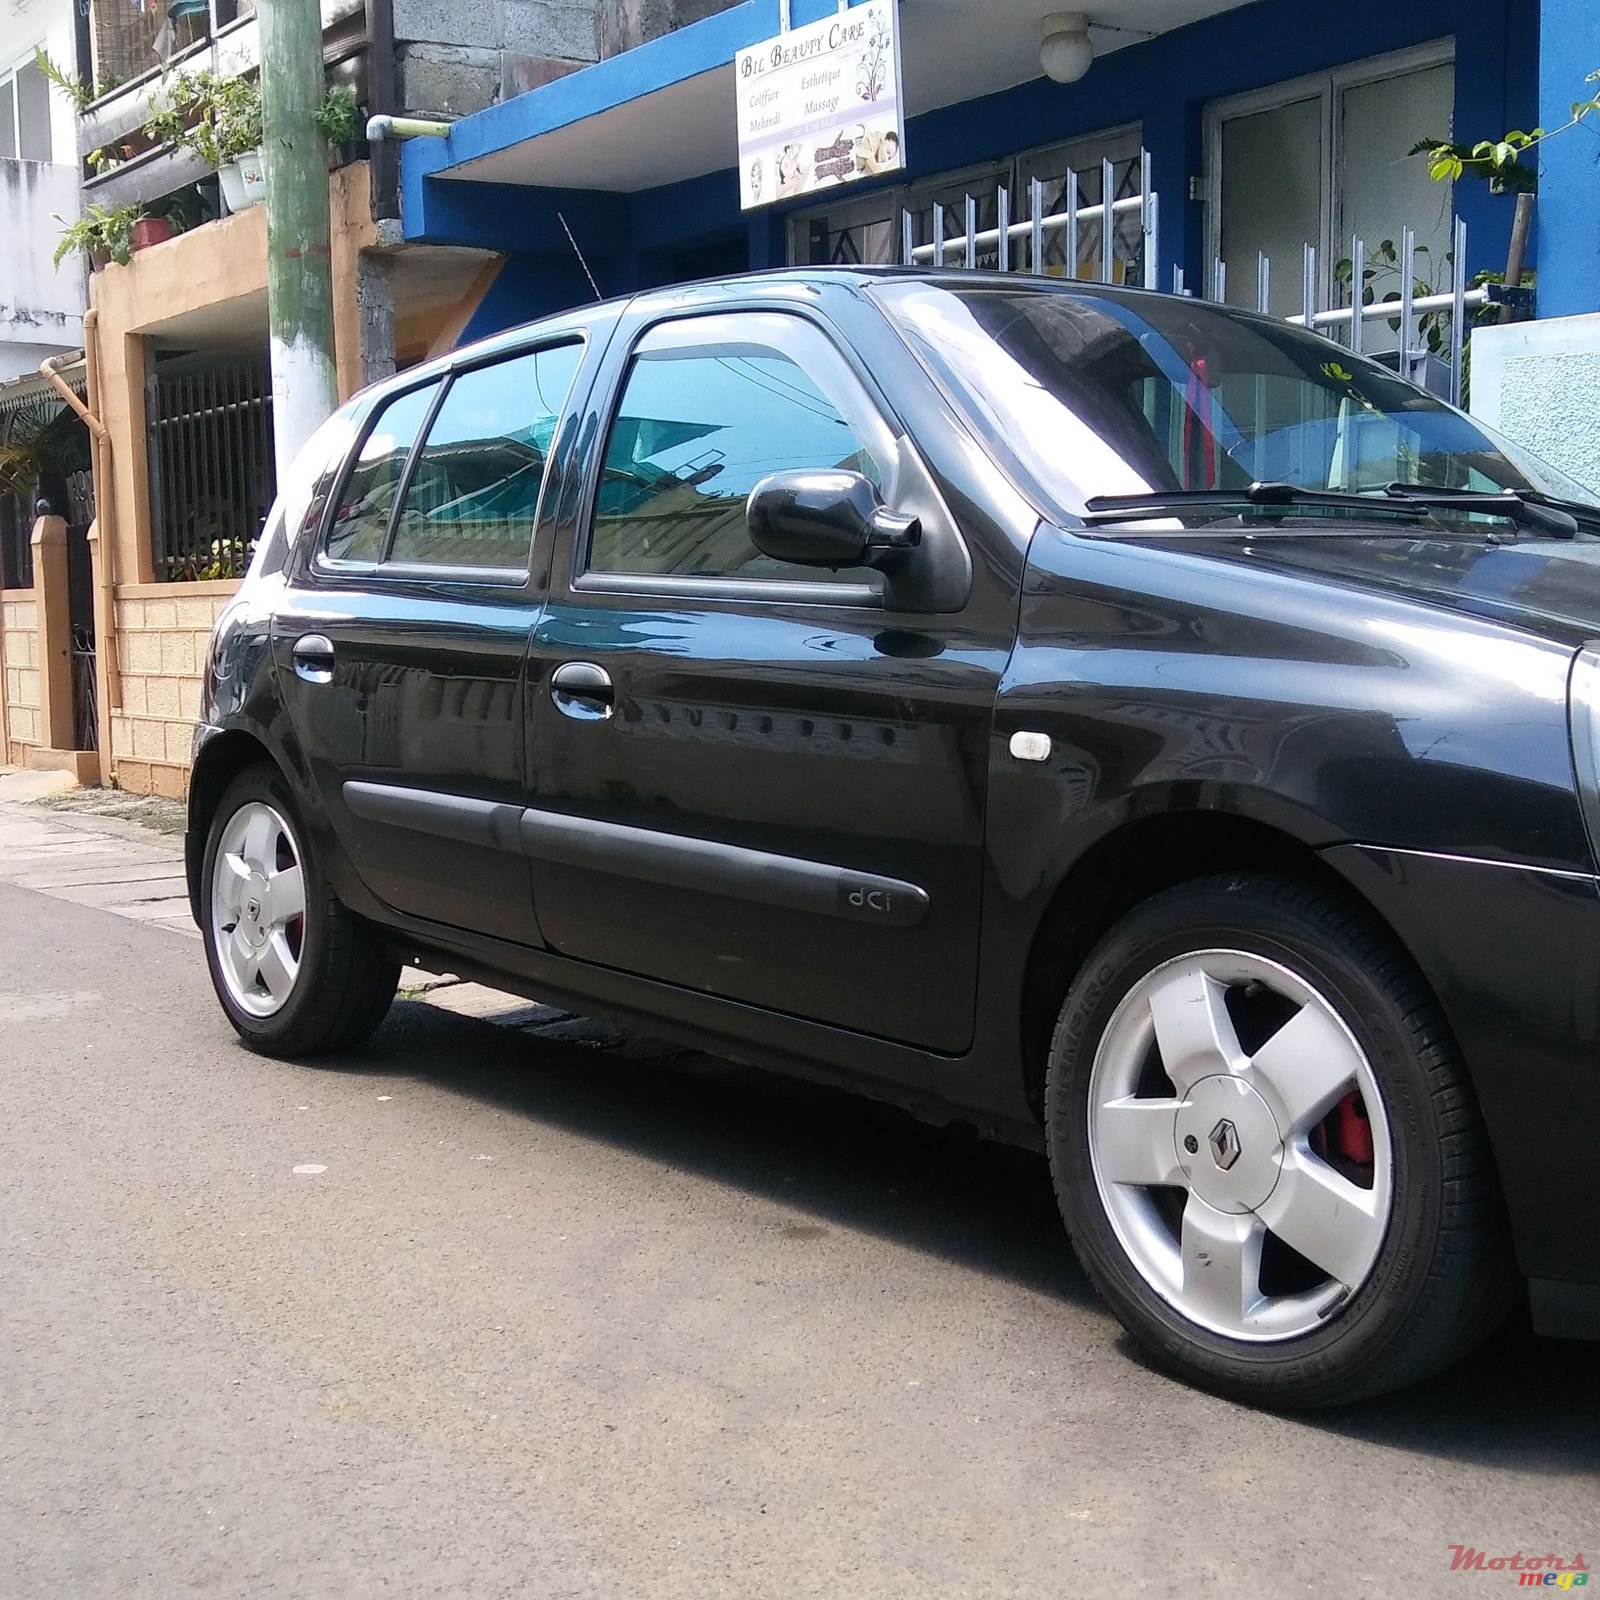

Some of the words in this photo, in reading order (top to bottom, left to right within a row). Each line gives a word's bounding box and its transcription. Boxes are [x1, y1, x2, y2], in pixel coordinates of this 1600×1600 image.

[801, 68, 841, 90] Esthetique
[749, 89, 779, 110] Coiffure
[804, 95, 840, 115] Massage
[749, 112, 781, 133] Mehendi
[848, 887, 892, 912] dCi
